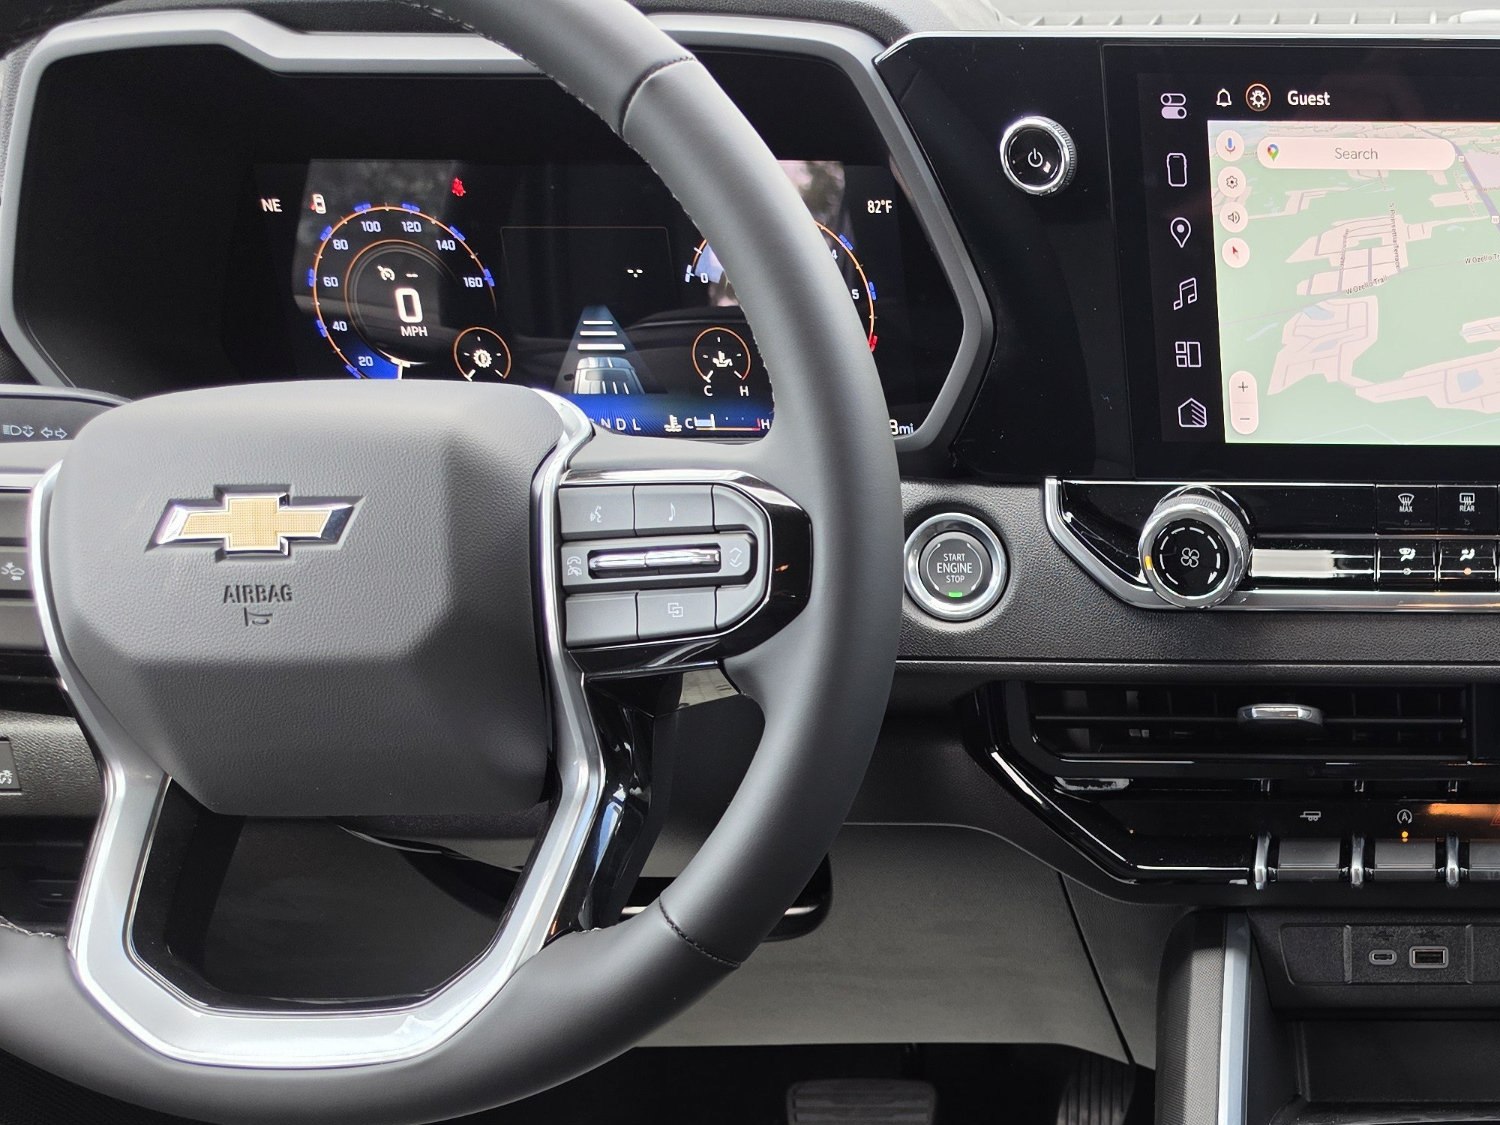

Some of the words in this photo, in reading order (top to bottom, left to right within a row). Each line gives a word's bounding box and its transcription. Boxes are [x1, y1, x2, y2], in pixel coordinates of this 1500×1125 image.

[1287, 90, 1330, 106] Guest
[1335, 148, 1378, 160] Search
[260, 199, 282, 213] NE
[867, 200, 893, 214] 82°F
[361, 221, 382, 233] 100
[401, 221, 422, 233] 120
[333, 239, 349, 251] 80
[436, 239, 456, 251] 140
[323, 276, 339, 288] 60
[463, 276, 484, 288] 160
[701, 273, 709, 284] 0
[851, 289, 860, 300] 5
[395, 288, 423, 324] 0
[333, 320, 348, 332] 40
[400, 326, 428, 337] MPH
[358, 356, 374, 367] 20
[704, 386, 713, 397] C
[740, 386, 749, 397] H
[616, 417, 627, 430] D
[632, 418, 641, 431] L
[685, 419, 694, 430] C
[761, 419, 770, 430] H
[1398, 504, 1413, 512] MAX
[1459, 504, 1475, 512] REAR
[943, 553, 965, 561] START
[937, 563, 973, 573] ENGINE
[946, 575, 965, 583] STOP
[223, 584, 293, 603] AIRBAG
